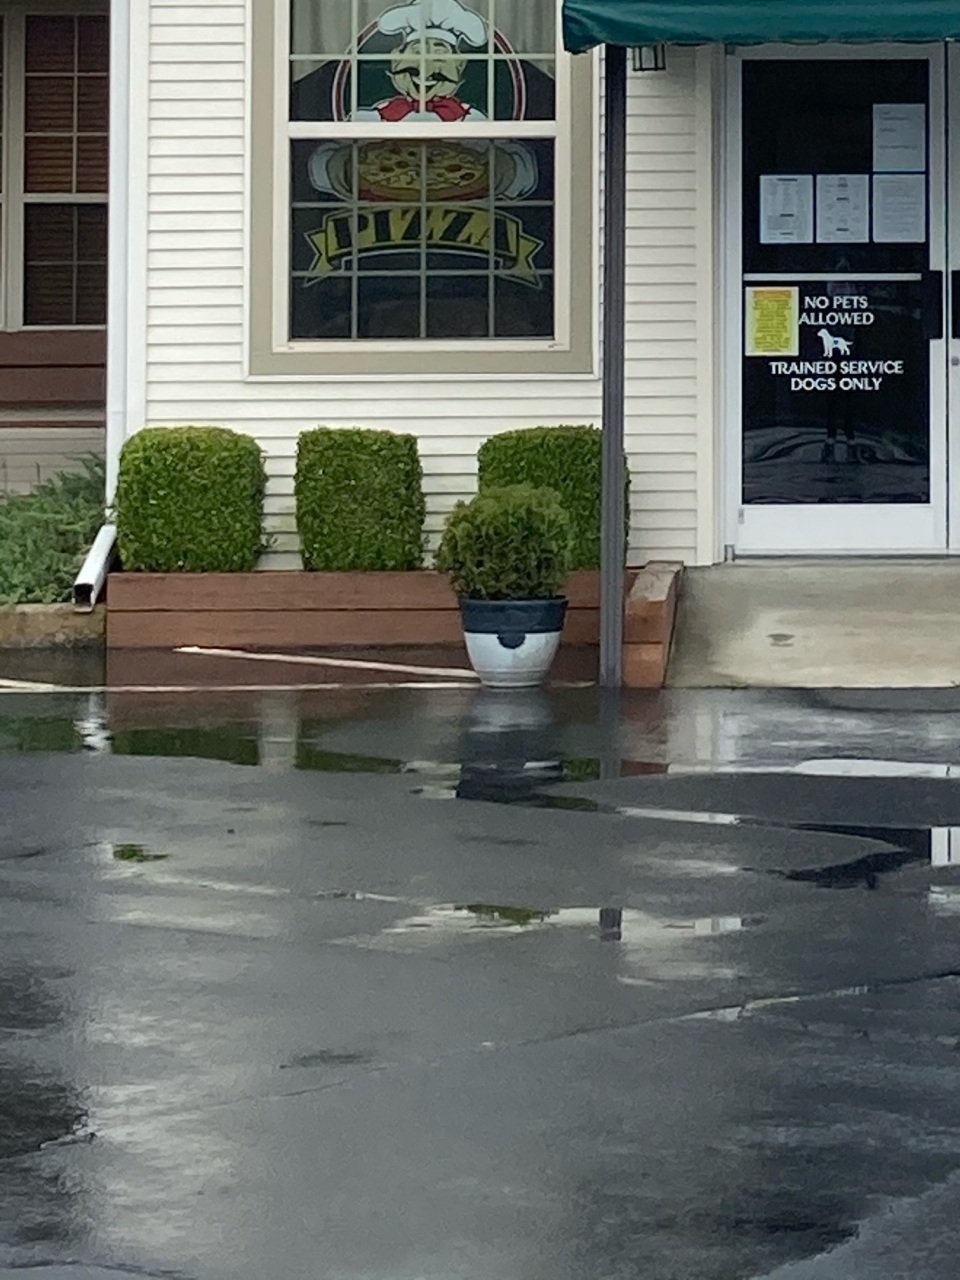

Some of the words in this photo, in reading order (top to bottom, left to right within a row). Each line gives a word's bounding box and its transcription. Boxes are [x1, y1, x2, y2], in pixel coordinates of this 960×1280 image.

[332, 208, 513, 253] PIZZA
[804, 295, 830, 310] NO
[833, 295, 868, 310] PETS
[798, 311, 874, 326] ALLOWED
[769, 360, 838, 375] TRAINED
[840, 359, 904, 374] SERVICE
[791, 376, 836, 391] DOGS
[839, 376, 883, 391] ONLY
